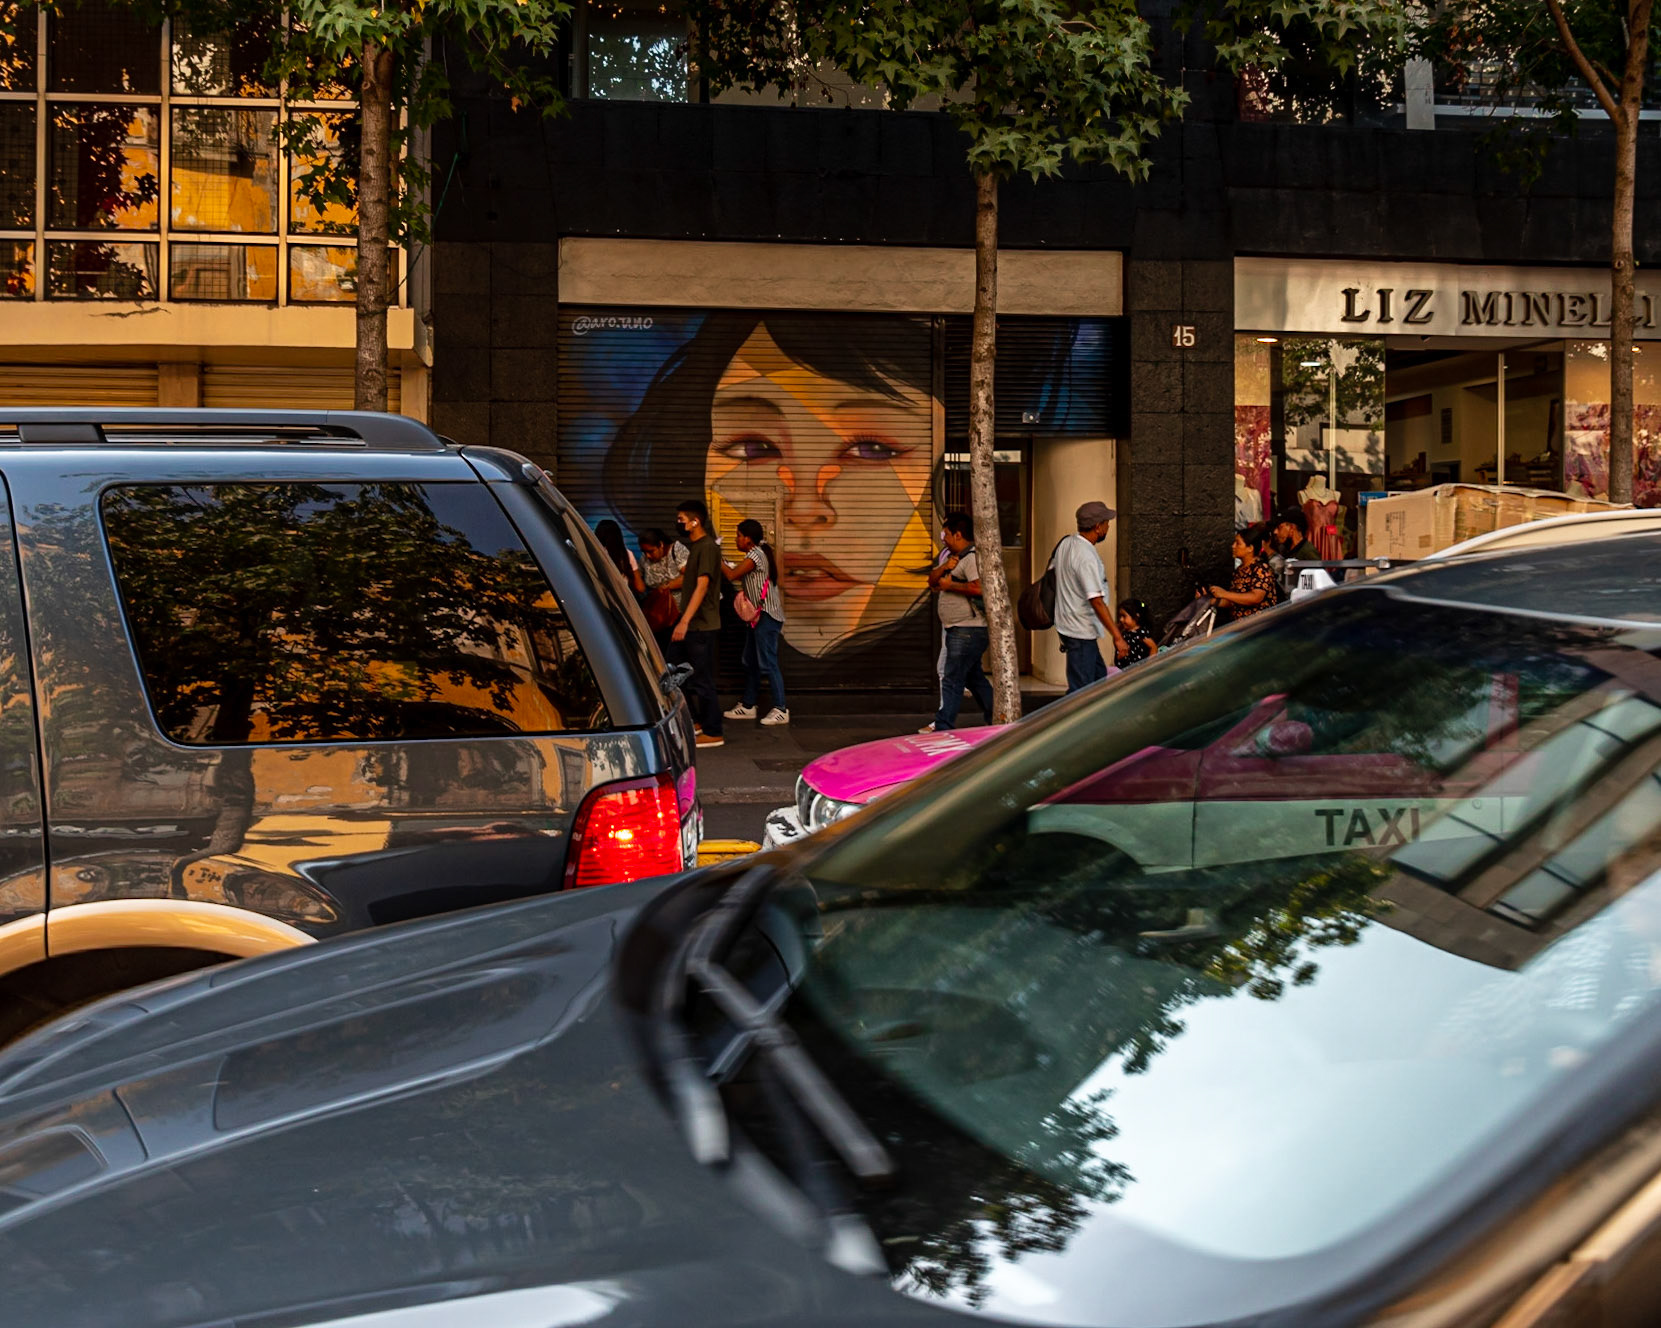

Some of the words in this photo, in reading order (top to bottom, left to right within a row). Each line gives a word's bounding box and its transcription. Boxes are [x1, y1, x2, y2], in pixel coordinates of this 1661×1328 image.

[1341, 288, 1435, 324] LIZ
[1461, 290, 1657, 329] MINELI
[1173, 325, 1195, 347] 15
[1301, 574, 1313, 590] TAXI
[1315, 807, 1420, 846] TAXI
